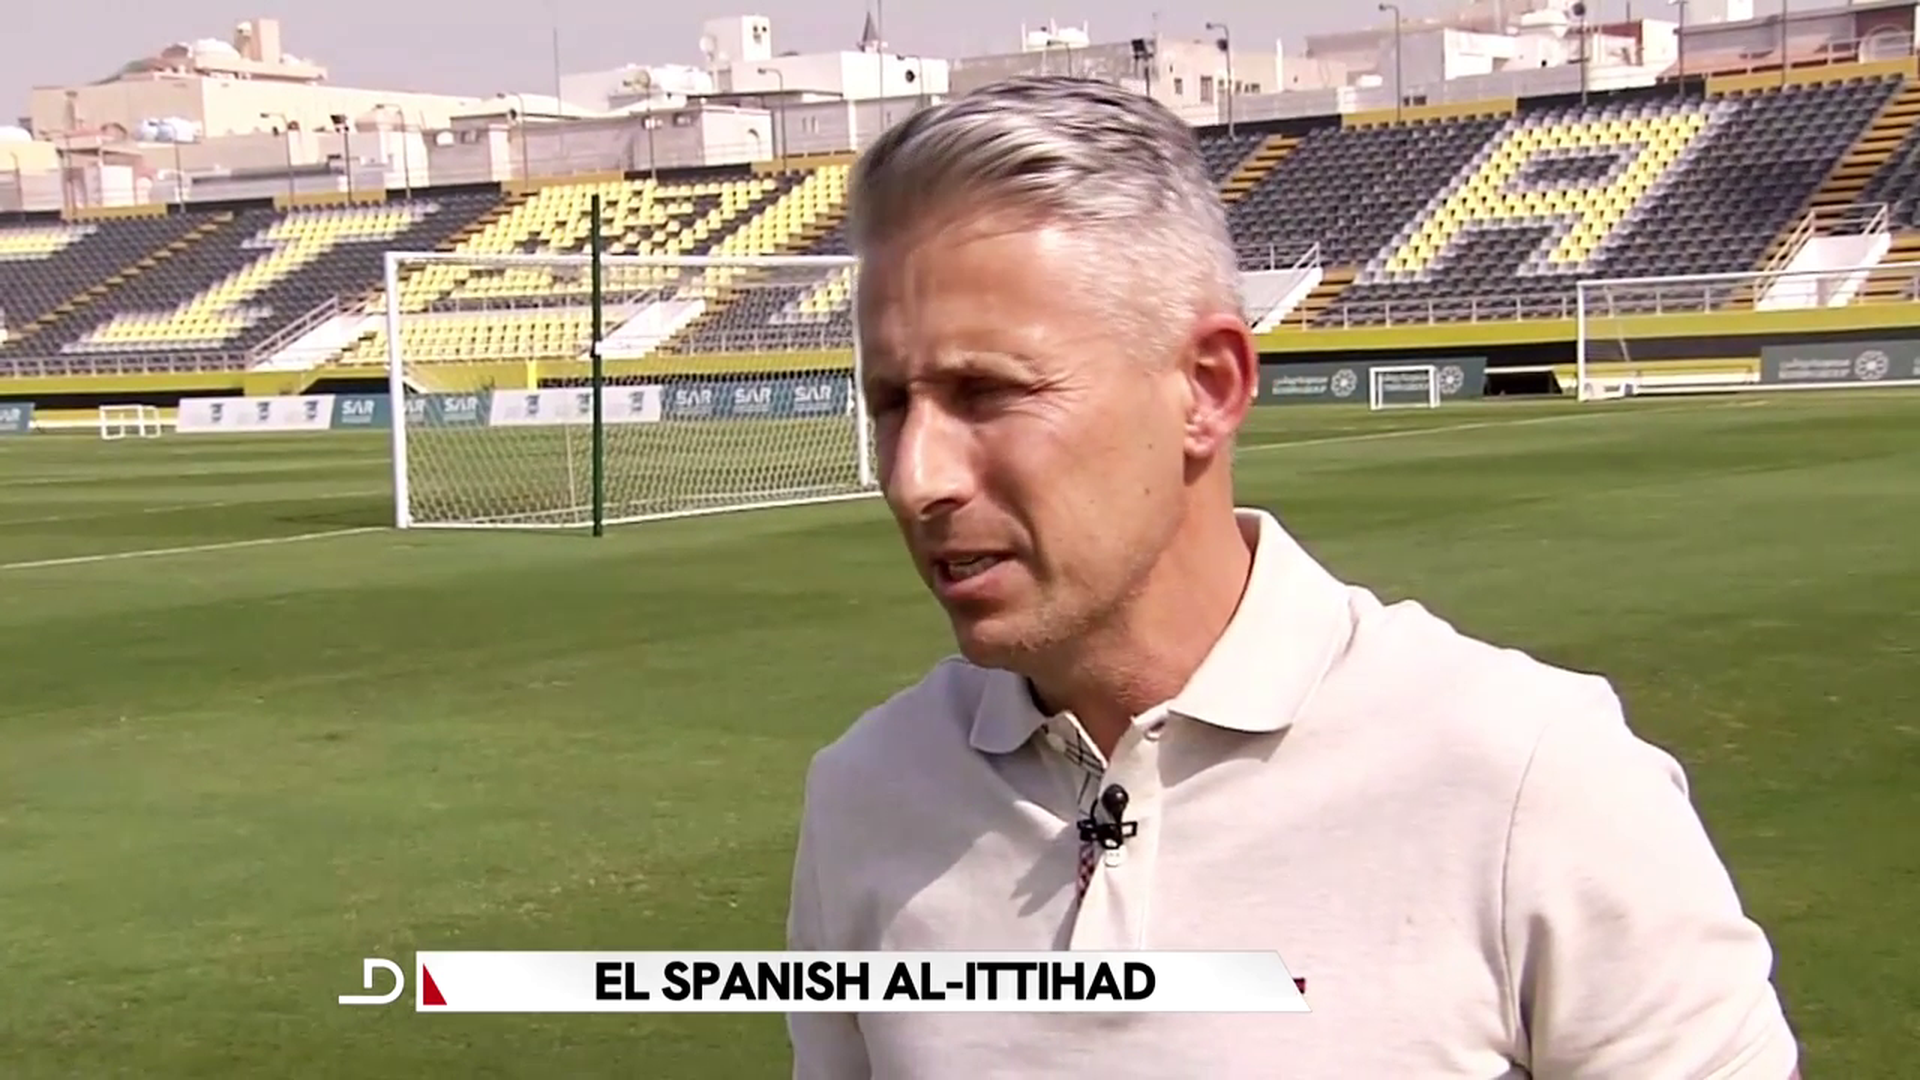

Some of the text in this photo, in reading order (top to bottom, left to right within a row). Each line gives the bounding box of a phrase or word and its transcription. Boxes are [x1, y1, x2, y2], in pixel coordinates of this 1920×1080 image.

[674, 389, 712, 405] SAR
[735, 387, 771, 404] SAR
[794, 385, 832, 402] SAR
[342, 400, 375, 415] SAR
[405, 399, 426, 414] AR
[444, 397, 477, 412] SAR
